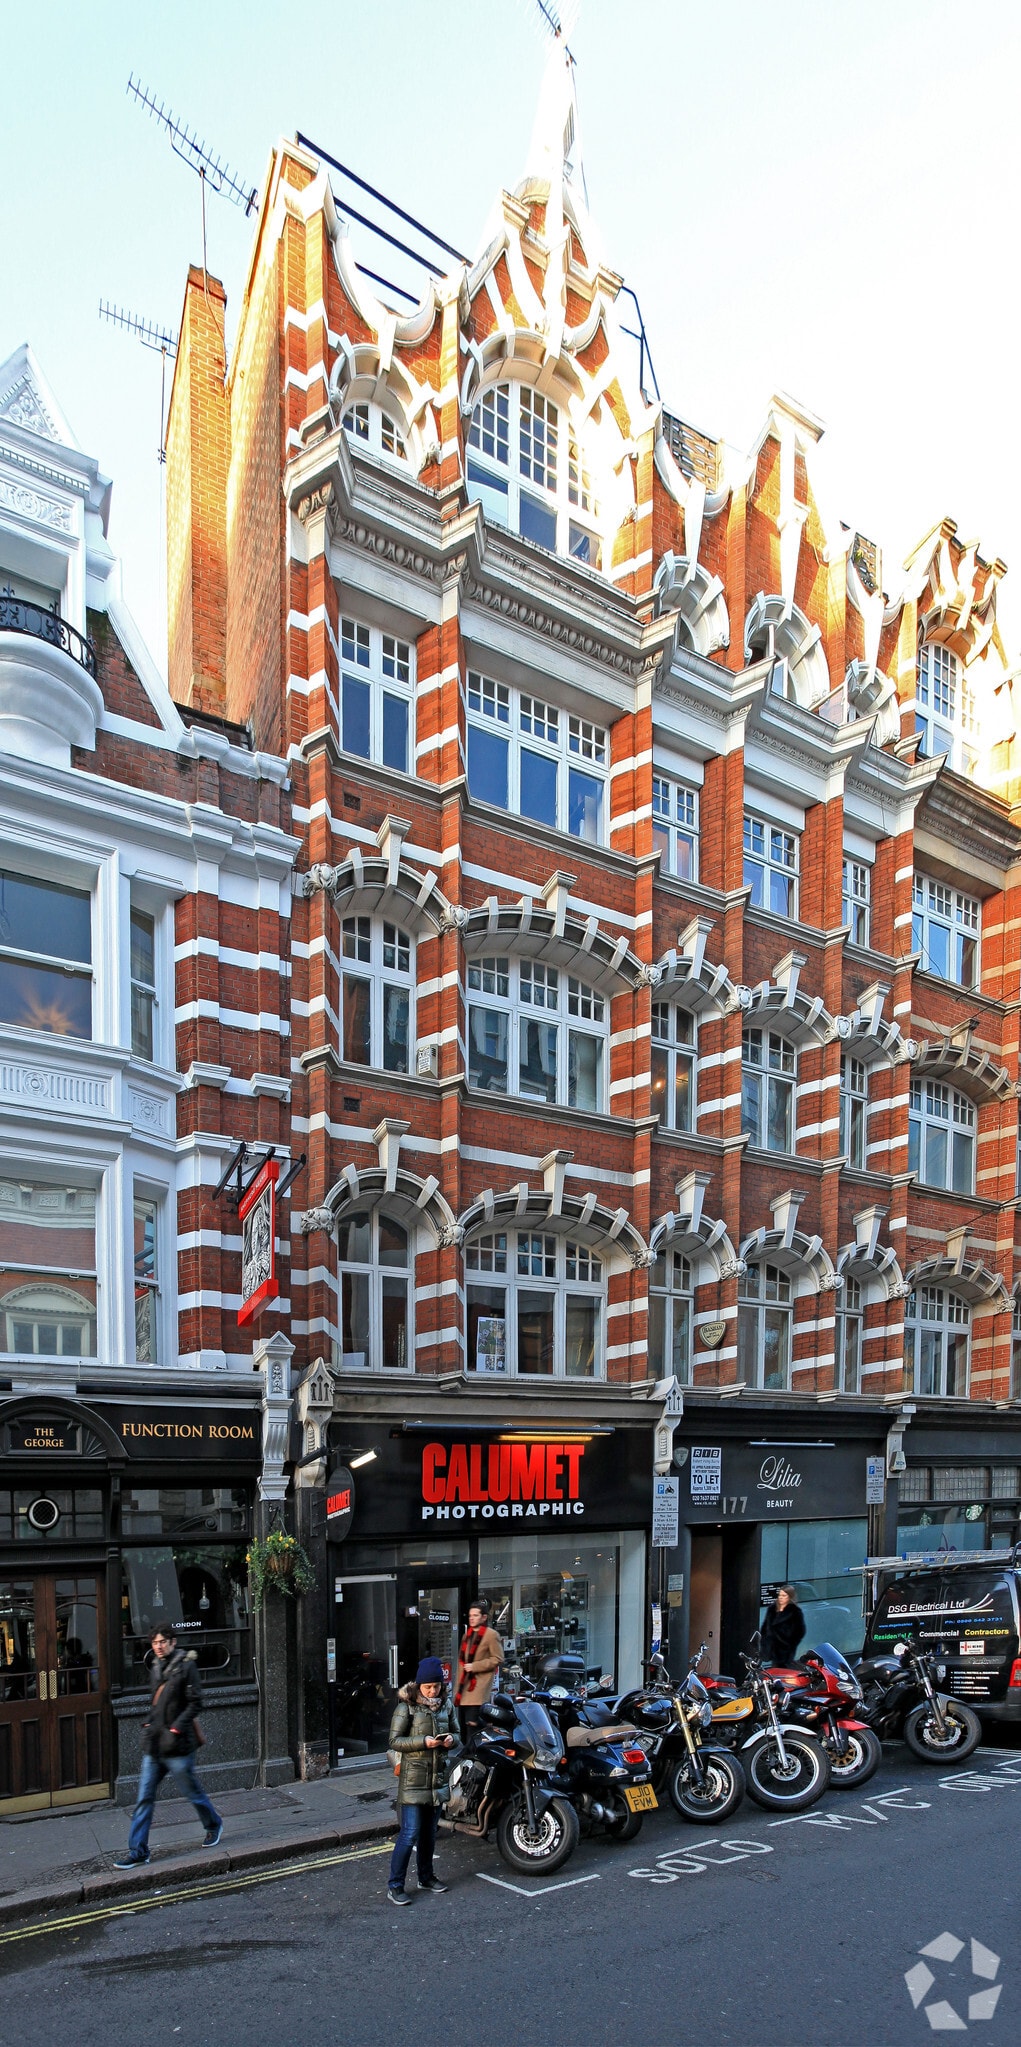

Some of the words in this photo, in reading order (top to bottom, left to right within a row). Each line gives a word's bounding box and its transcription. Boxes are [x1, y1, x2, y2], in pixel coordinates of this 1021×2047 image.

[34, 1427, 54, 1437] THE
[121, 1423, 203, 1438] FUNCTION
[208, 1425, 254, 1439] ROOM
[24, 1438, 64, 1448] GEORGE
[693, 1449, 720, 1458] RIB
[422, 1442, 585, 1503] CALUMET
[756, 1455, 803, 1491] Lilia
[692, 1475, 703, 1484] TO
[705, 1475, 719, 1484] LET
[327, 1488, 351, 1514] CALUMET
[722, 1496, 748, 1515] 177
[766, 1499, 793, 1508] BEAUTY
[421, 1502, 585, 1520] PHOTOGRAPHIC
[888, 1604, 908, 1613] DSG
[909, 1601, 949, 1612] Electrical
[950, 1599, 965, 1609] Ltd
[428, 1614, 450, 1622] CLOSED
[171, 1621, 202, 1629] LONDON
[919, 1629, 960, 1637] Commercial
[964, 1628, 1010, 1636] Contractors
[627, 1839, 775, 1884] SOLO
[801, 1798, 932, 1830] M/C
[938, 1767, 1021, 1792] ONLY
